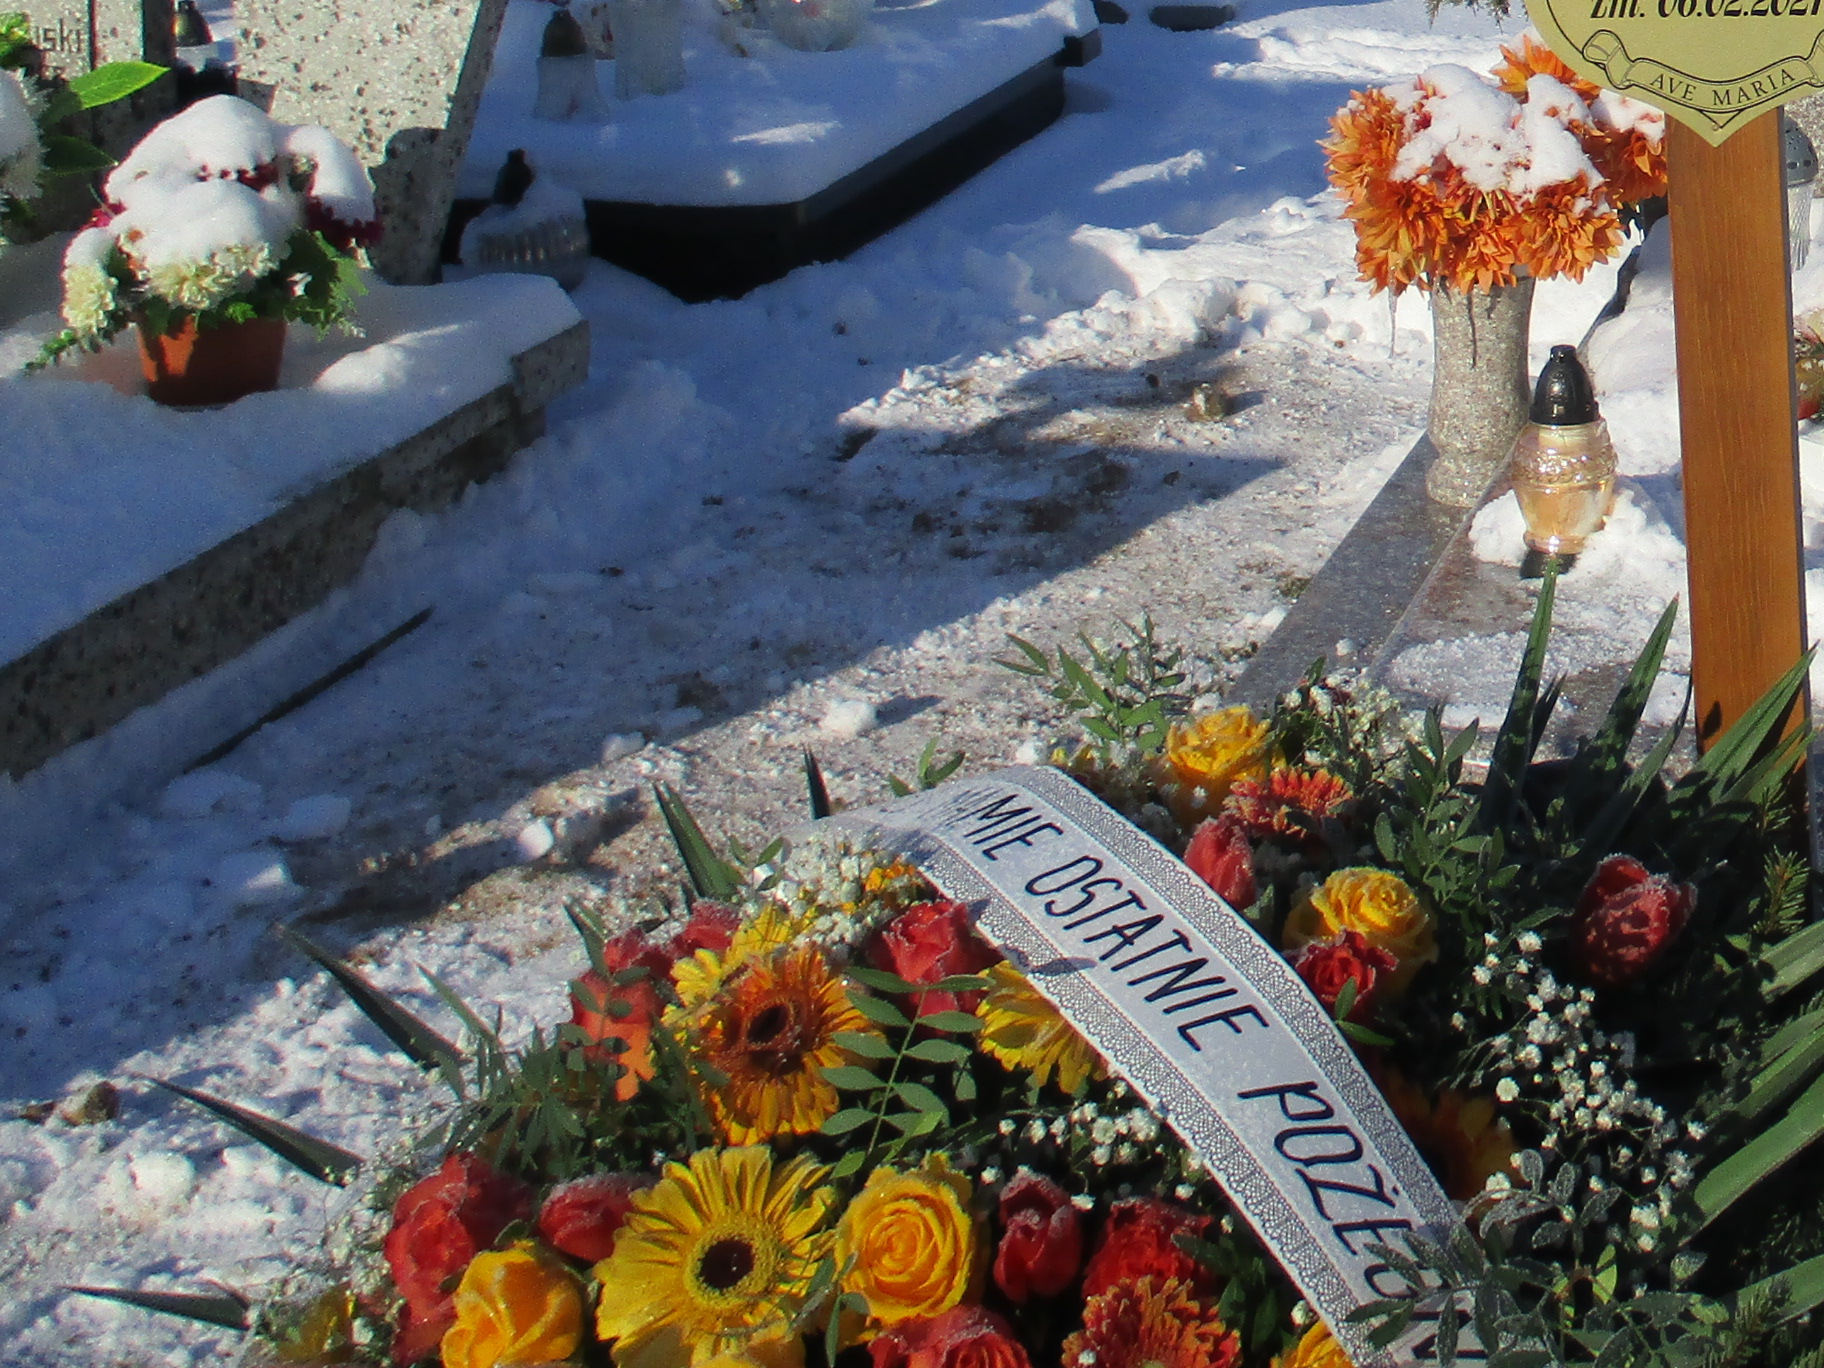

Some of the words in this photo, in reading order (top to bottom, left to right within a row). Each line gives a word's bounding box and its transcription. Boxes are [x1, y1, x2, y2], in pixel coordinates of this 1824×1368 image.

[1649, 72, 1696, 102] AVE
[1711, 67, 1796, 107] MARIA
[1025, 854, 1269, 1052] OSTATNIE
